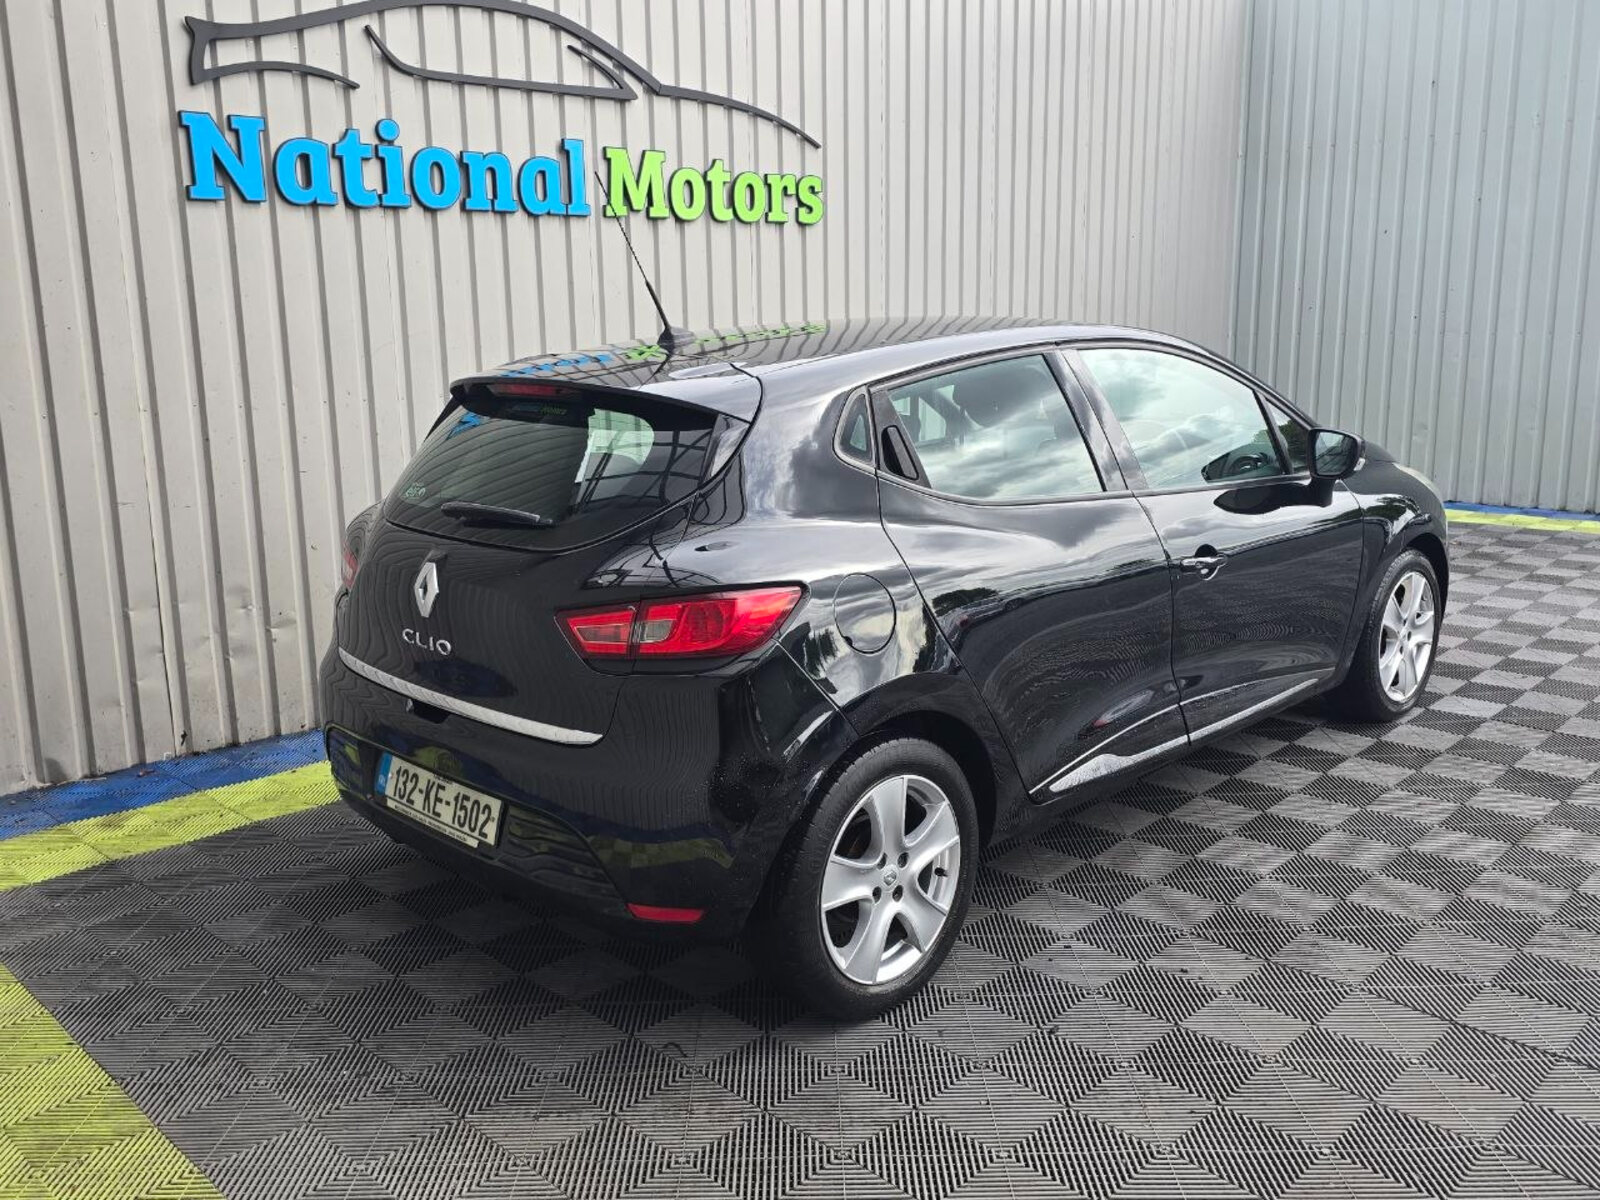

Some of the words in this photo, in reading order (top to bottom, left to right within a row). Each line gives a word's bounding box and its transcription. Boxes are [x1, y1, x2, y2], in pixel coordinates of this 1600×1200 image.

[178, 110, 591, 217] National
[603, 145, 824, 226] Motors
[401, 627, 452, 656] CLIO
[393, 765, 493, 839] 132-KE-1502
